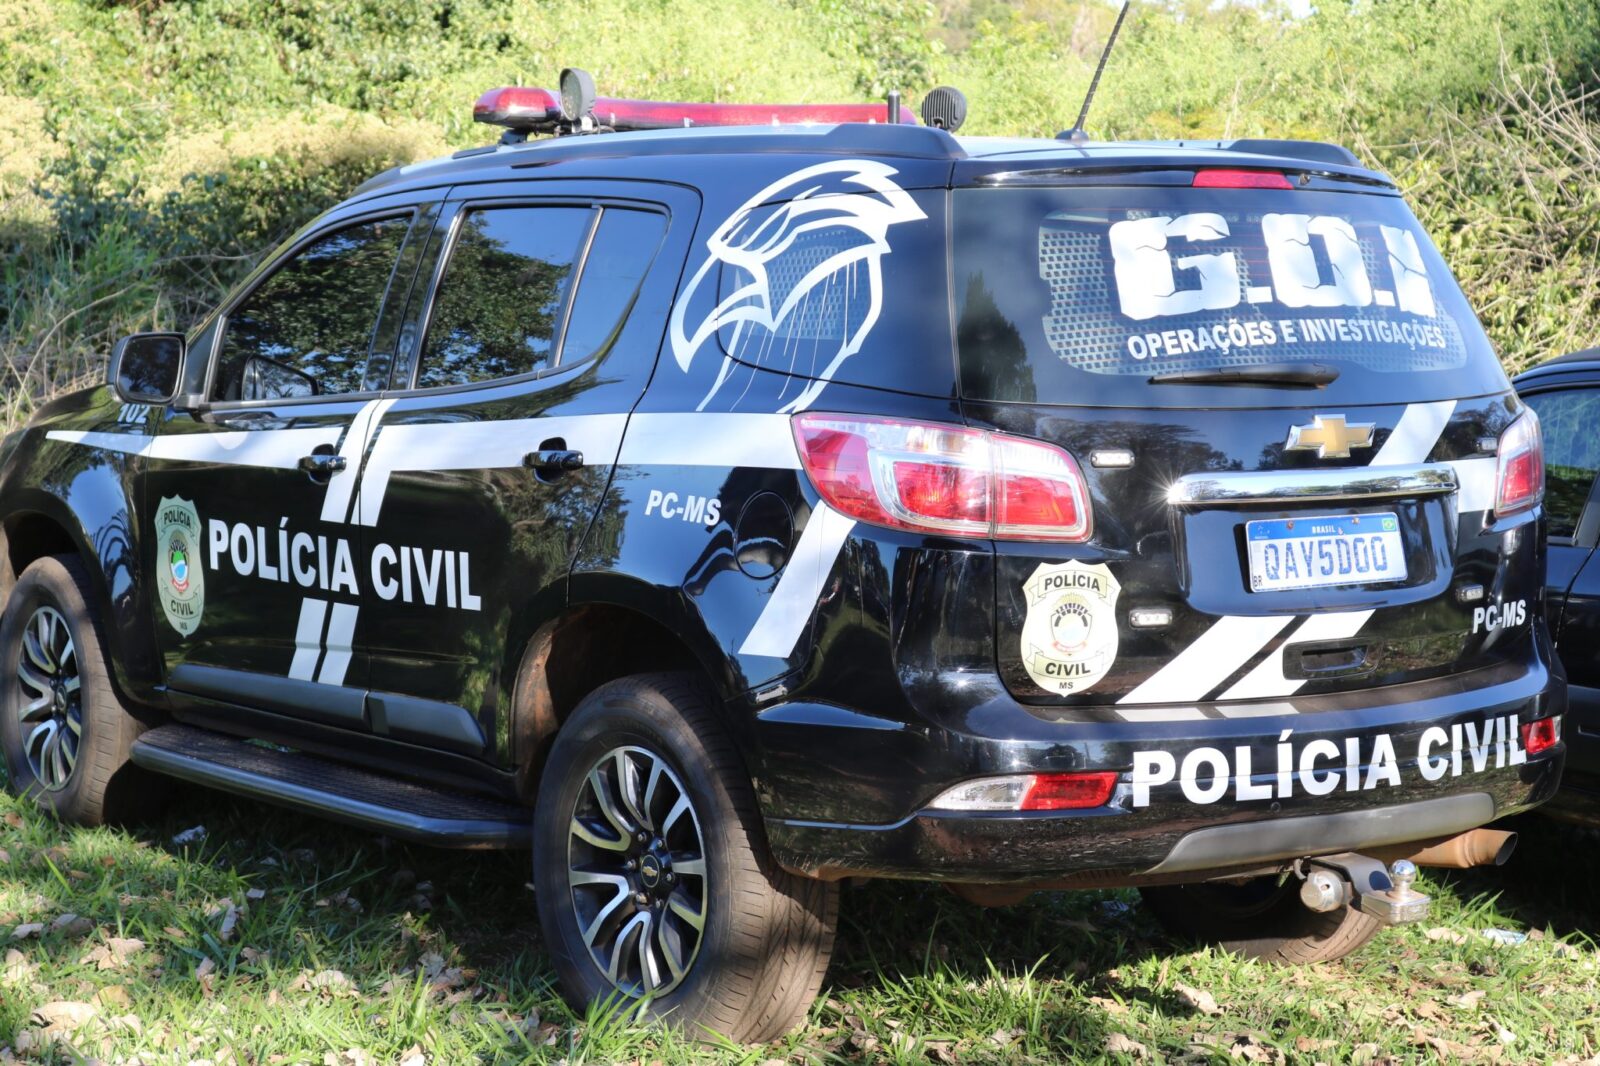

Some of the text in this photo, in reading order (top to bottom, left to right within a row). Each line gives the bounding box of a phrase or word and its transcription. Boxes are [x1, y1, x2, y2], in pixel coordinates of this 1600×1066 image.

[1127, 319, 1446, 360] OPERAÇÕES E INVESTIGAÇÕES
[117, 403, 151, 424] 102
[164, 508, 191, 528] POLÍCIA
[645, 490, 721, 526] PC-MS
[1312, 525, 1336, 534] BRASIL
[208, 516, 481, 611] POLÍCIA CIVIL
[1264, 536, 1388, 580] QAY5D00
[1044, 571, 1100, 591] POLÍCIA
[1253, 575, 1263, 587] BR
[170, 600, 194, 616] CIVIL
[1472, 600, 1526, 634] PC-MS
[1045, 662, 1091, 676] CIVIL
[1059, 682, 1074, 690] MS
[1132, 714, 1527, 807] POLÍCIA CIVIL
